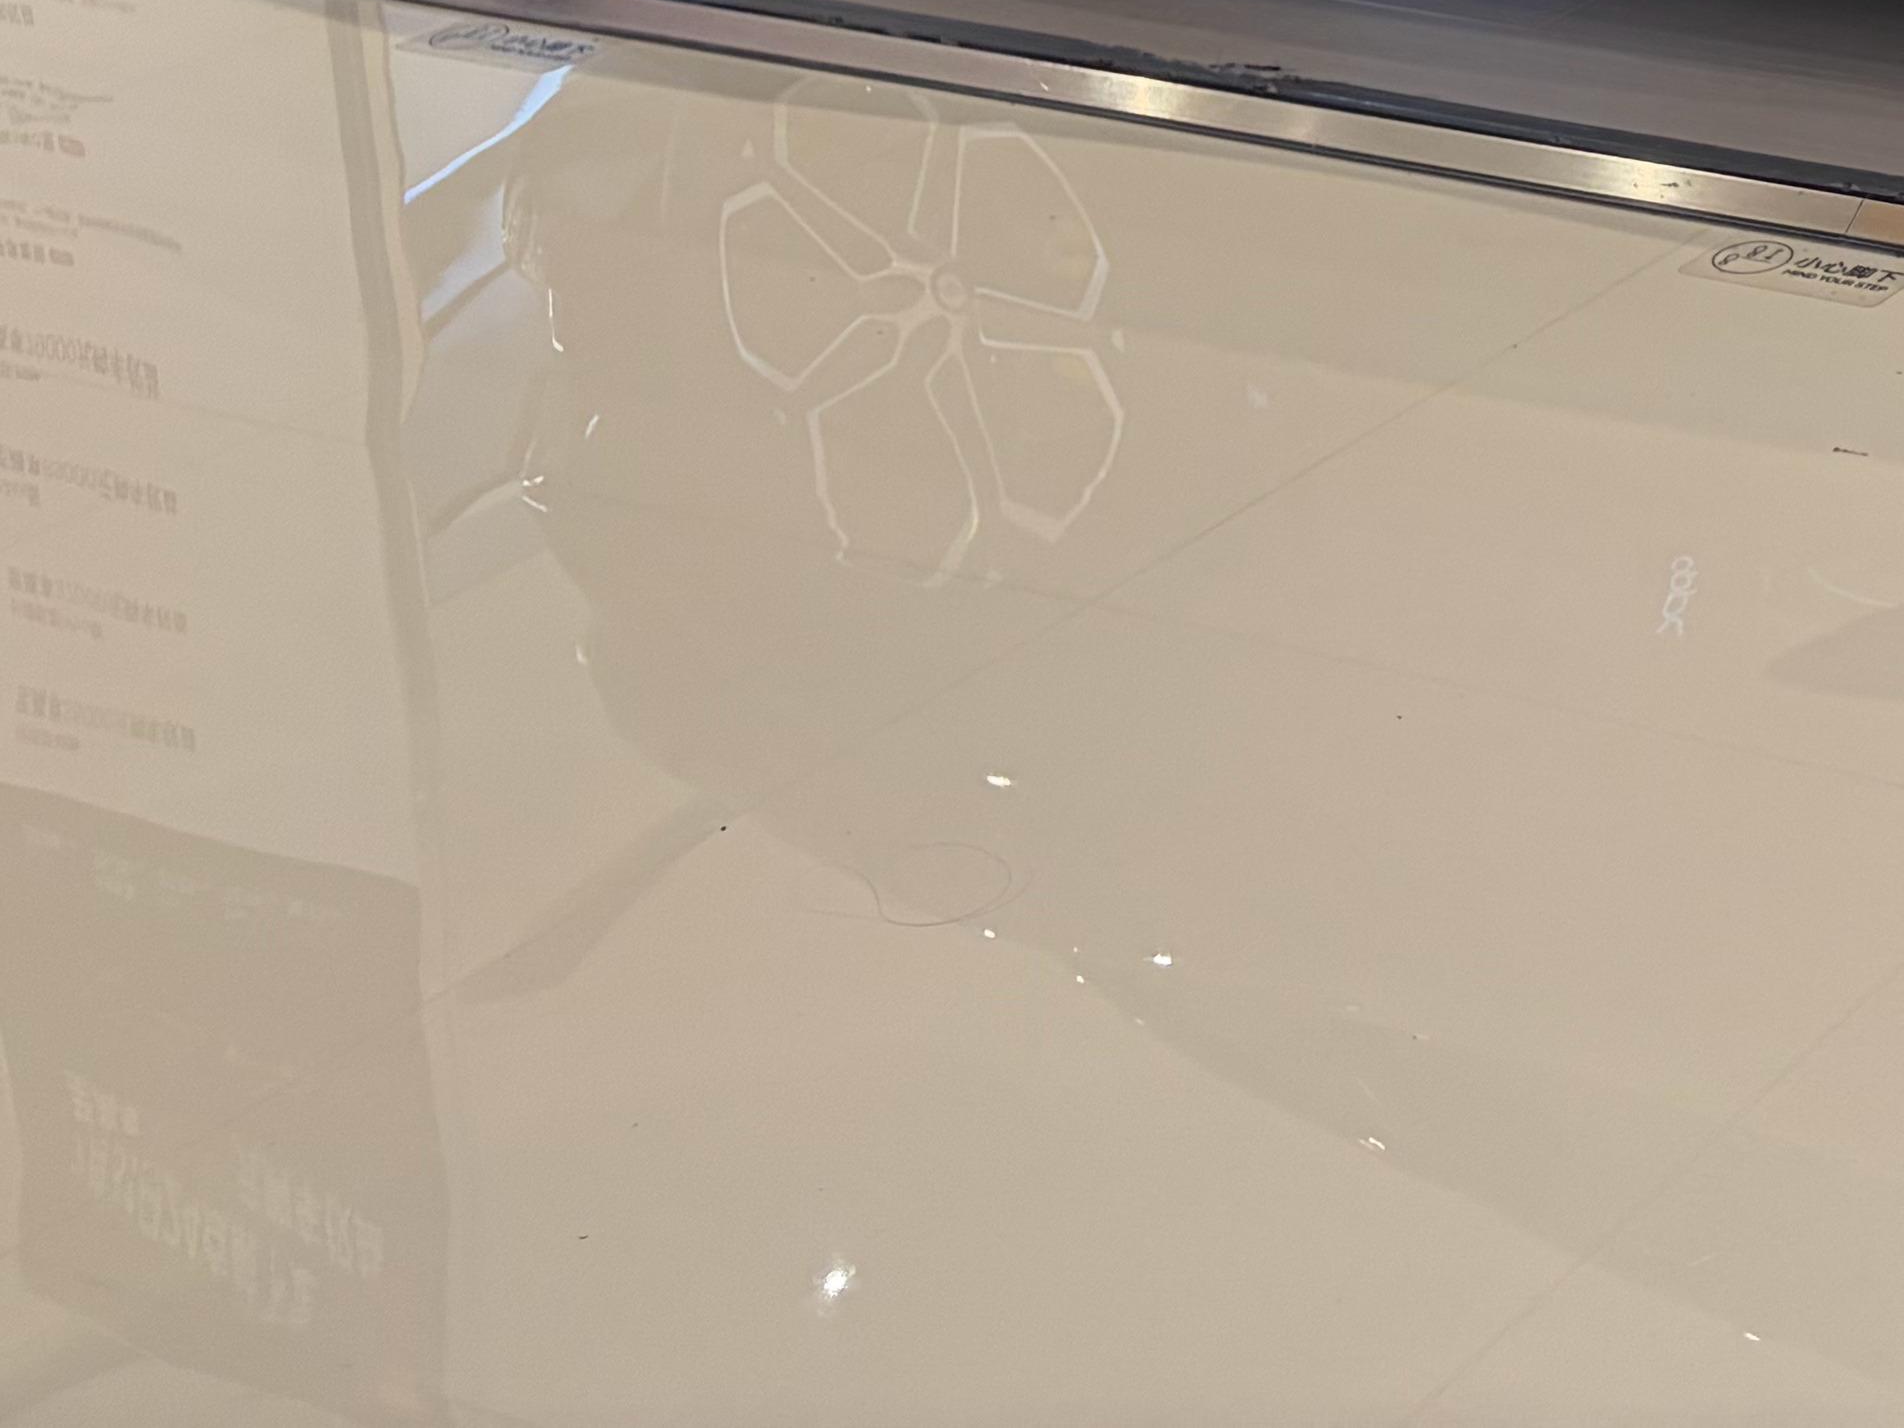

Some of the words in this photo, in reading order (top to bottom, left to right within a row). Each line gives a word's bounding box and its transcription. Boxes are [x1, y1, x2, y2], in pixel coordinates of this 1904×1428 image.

[1781, 268, 1818, 281] MIND
[1818, 273, 1854, 288] YOUR
[1854, 280, 1890, 294] STEP
[1794, 256, 1904, 282] 小心脚下
